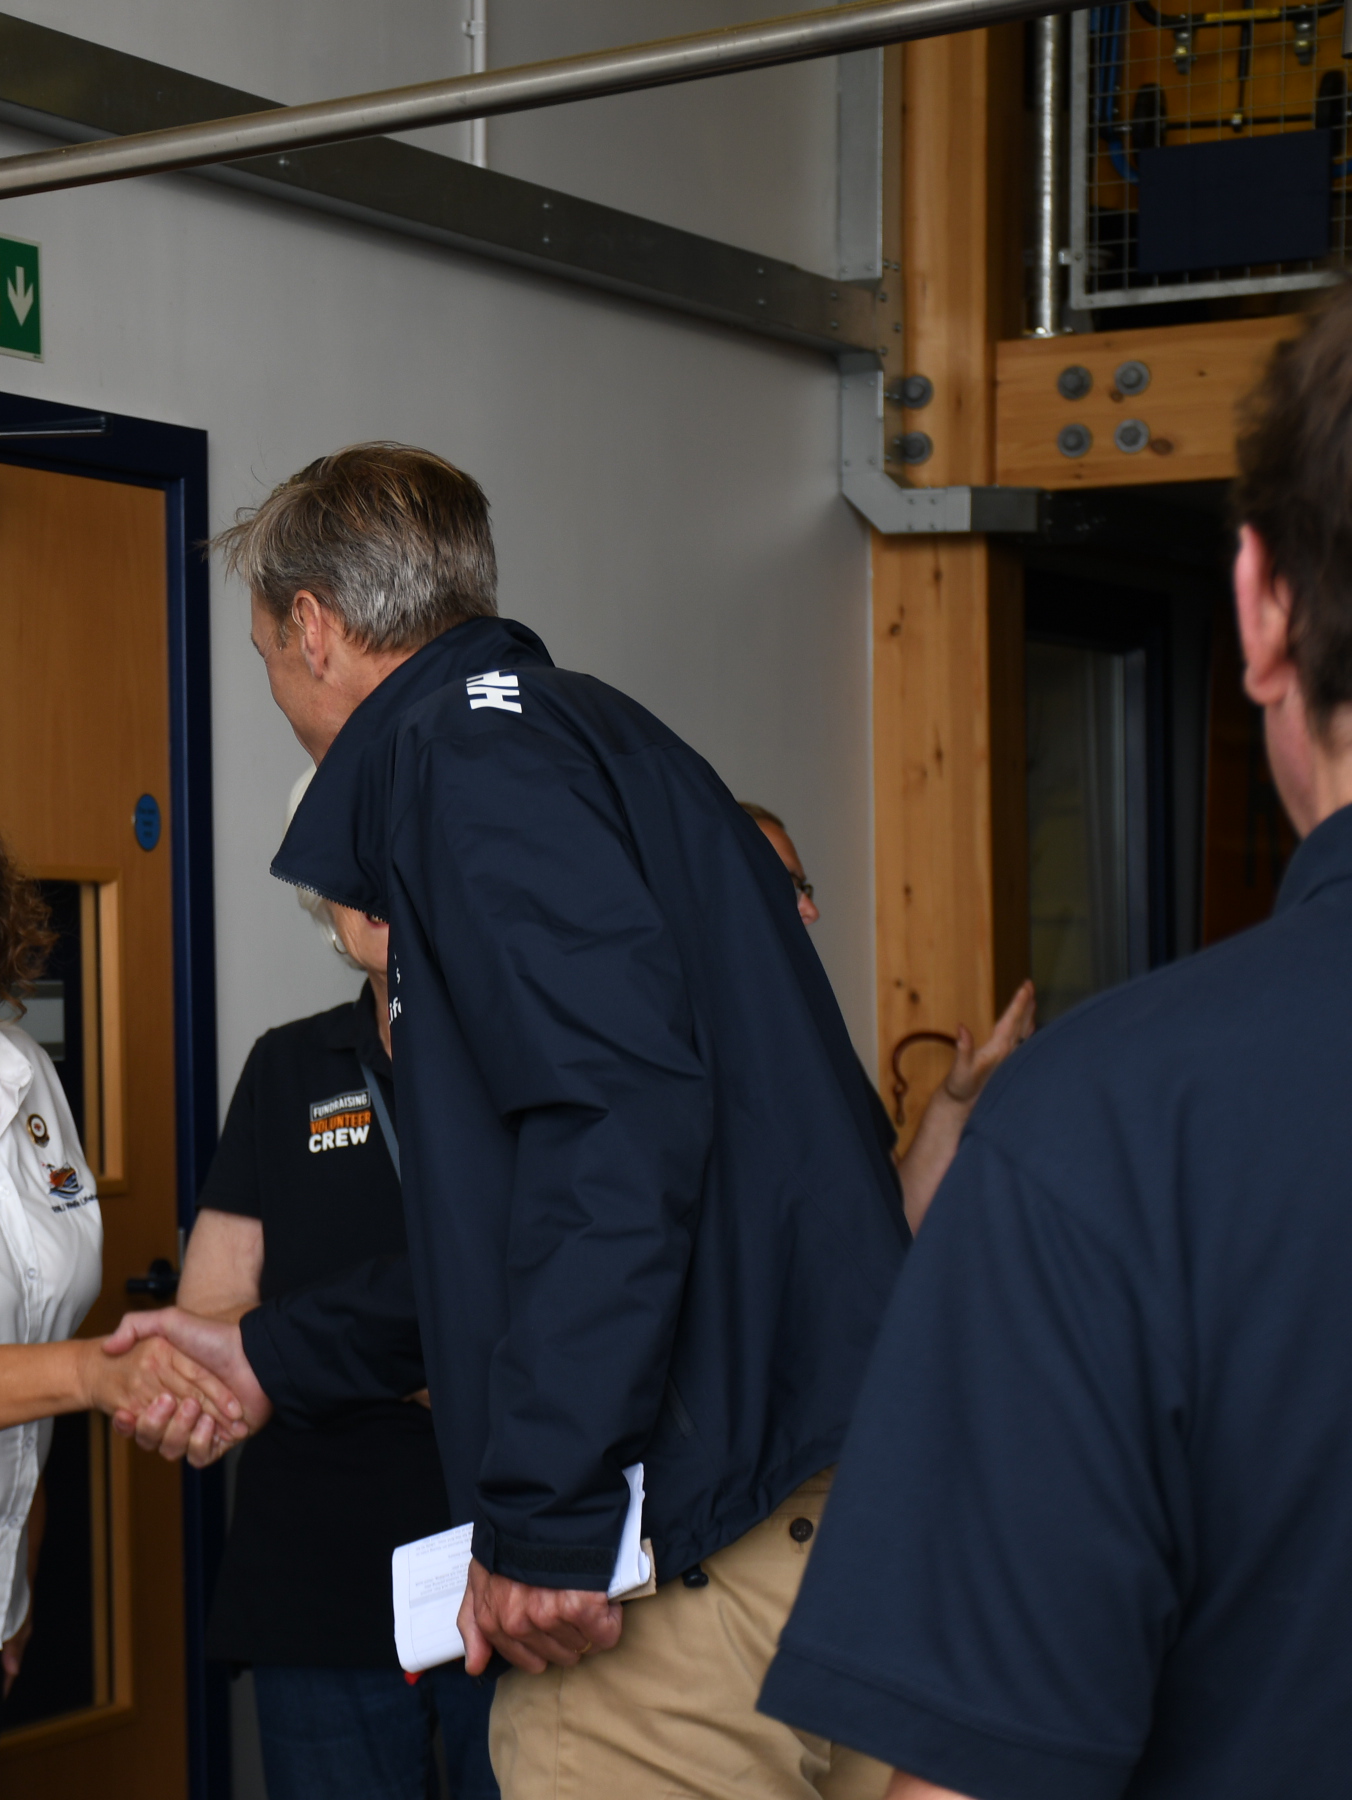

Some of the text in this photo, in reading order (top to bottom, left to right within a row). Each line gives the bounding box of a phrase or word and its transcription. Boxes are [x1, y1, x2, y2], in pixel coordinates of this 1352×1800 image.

[313, 1093, 368, 1118] FUNDRAISING
[310, 1110, 372, 1135] VOLUNTEER
[308, 1124, 370, 1154] CREW
